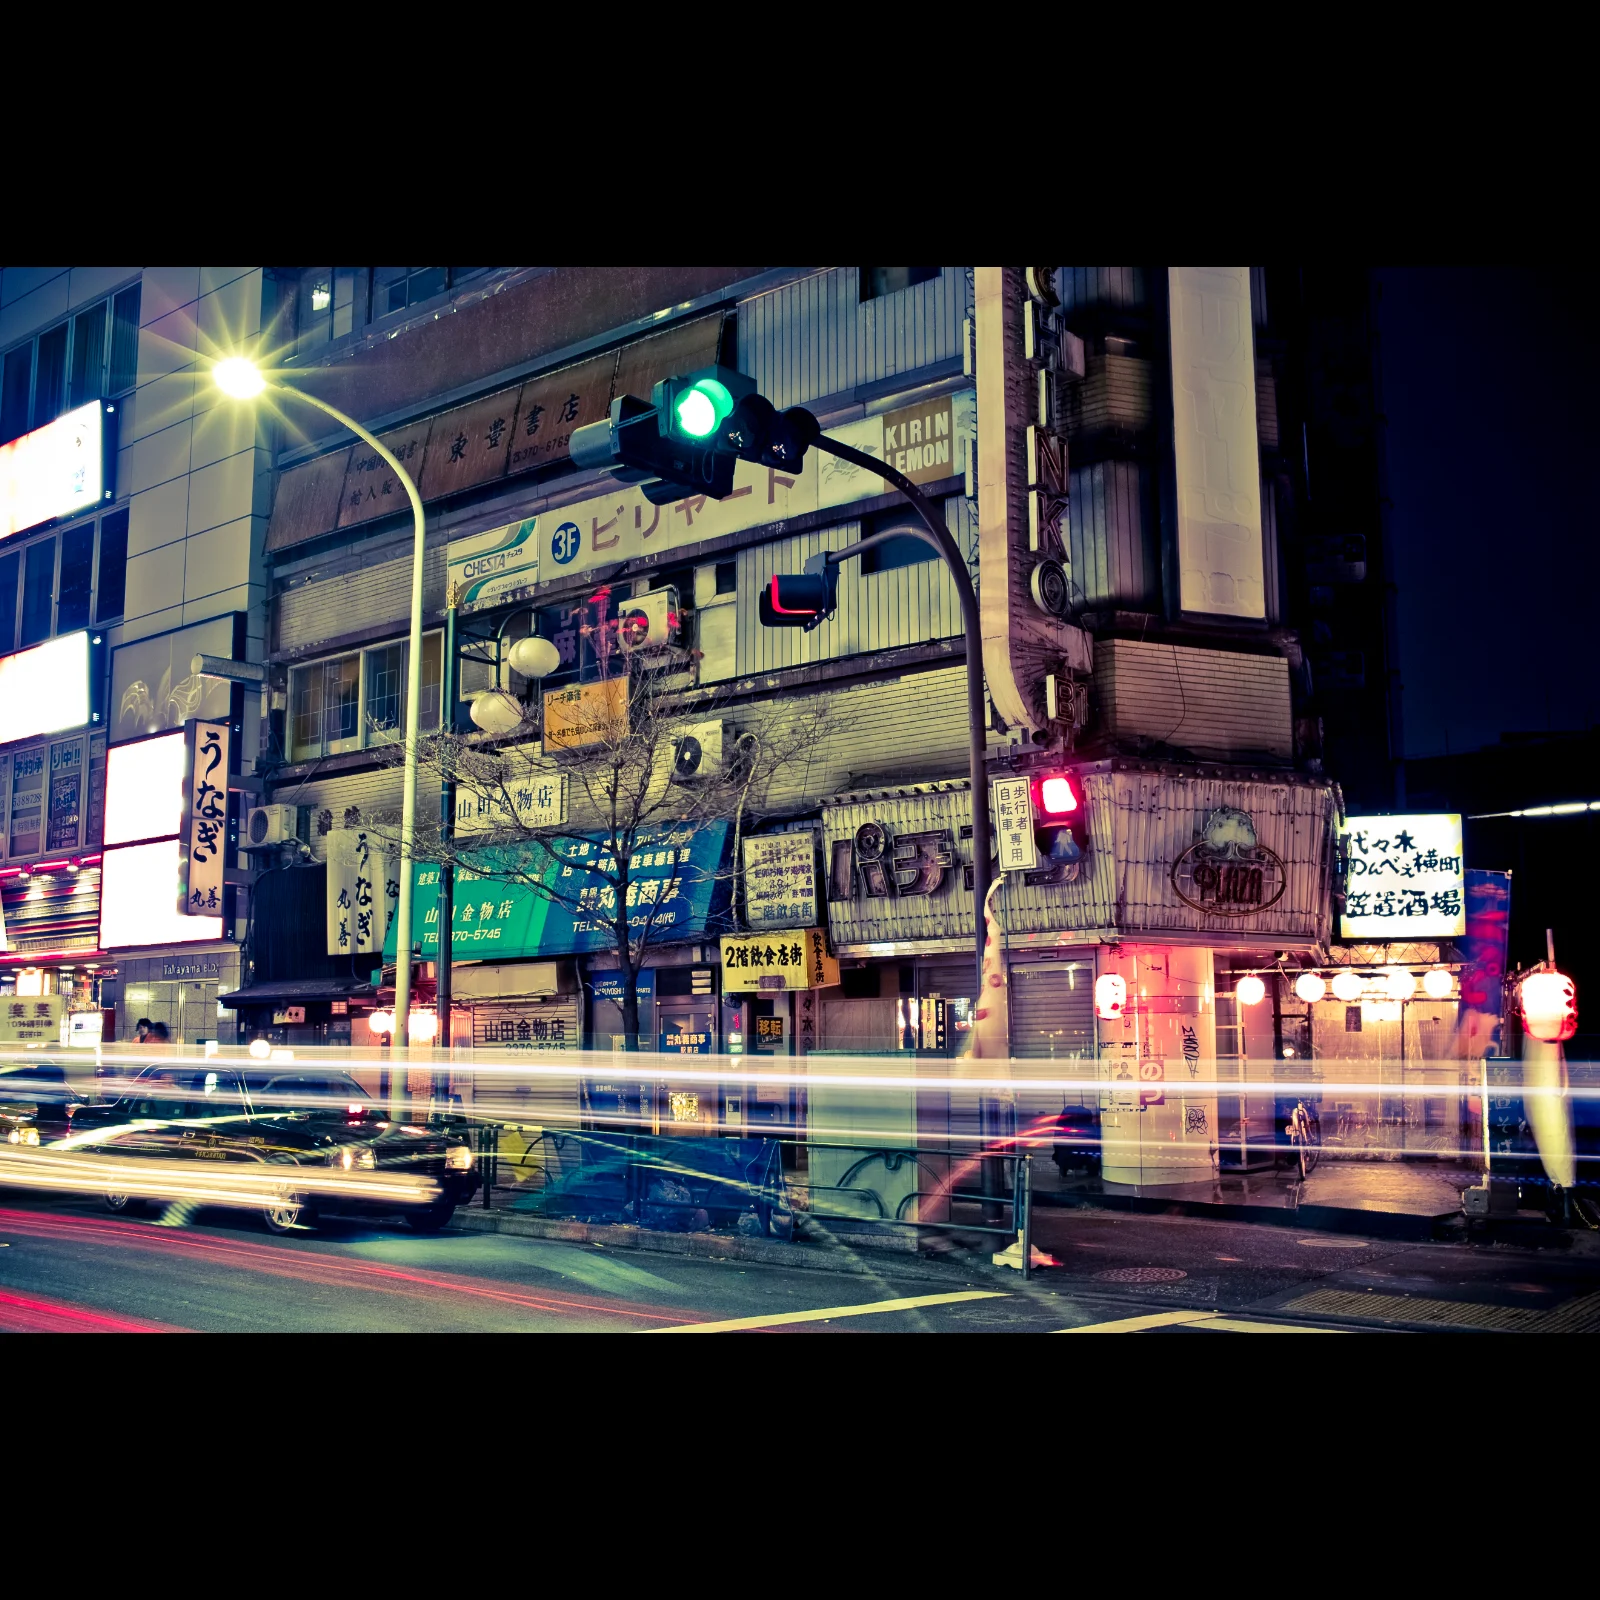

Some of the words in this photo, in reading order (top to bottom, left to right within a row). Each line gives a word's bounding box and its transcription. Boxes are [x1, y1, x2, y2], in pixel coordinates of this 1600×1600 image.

[885, 411, 949, 451] KIRIN
[554, 527, 577, 561] 3F
[463, 551, 506, 578] CHESTA
[193, 731, 225, 863] うなぎ
[1000, 787, 1013, 831] 自転車
[1013, 786, 1028, 830] 歩行者
[1009, 833, 1023, 862] 専用
[1350, 830, 1417, 855] 代々木
[190, 886, 221, 909] 丸善
[355, 833, 373, 946] うなぎ
[1346, 889, 1461, 918] 笠置酒場
[337, 888, 351, 947] 丸善
[424, 900, 514, 924] 山金物店
[752, 902, 812, 921] 二階飲食街
[163, 963, 201, 976] Takayama
[725, 943, 802, 968] 2階飲食店街
[812, 932, 824, 983] 飲食店街
[485, 1018, 564, 1041] 山田金物店
[759, 1019, 782, 1036] 移転
